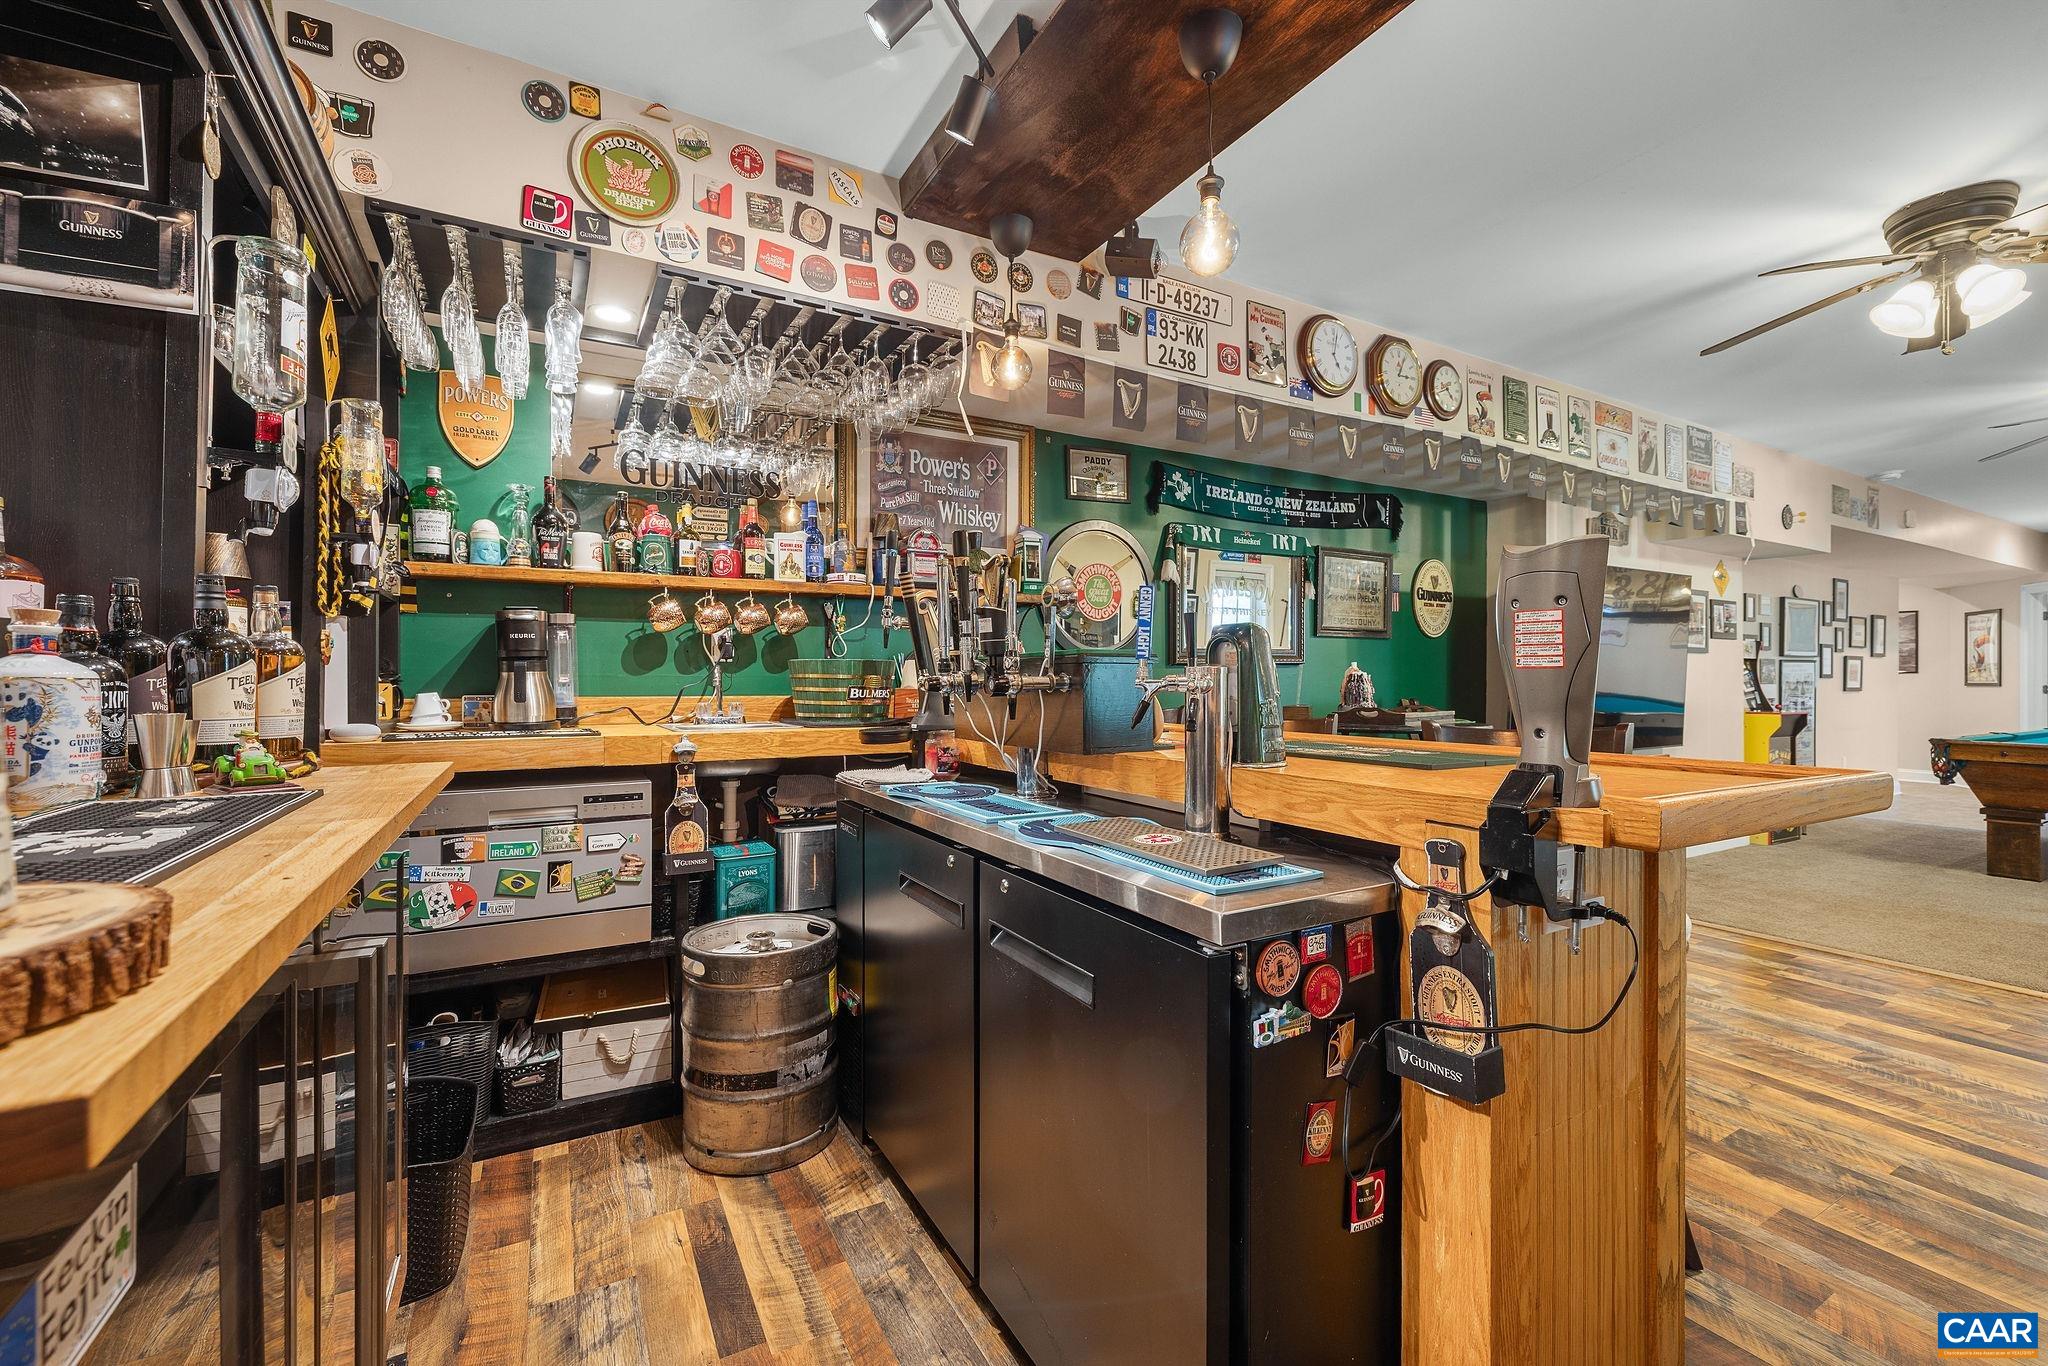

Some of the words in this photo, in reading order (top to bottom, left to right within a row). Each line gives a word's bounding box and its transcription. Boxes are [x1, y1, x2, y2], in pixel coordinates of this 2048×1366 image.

[291, 35, 330, 51] GUINNESS
[592, 136, 664, 171] PHOENIX
[831, 170, 860, 206] RASCALS
[603, 187, 656, 207] DRAUGHT
[615, 197, 644, 211] BEER
[59, 219, 123, 240] GUINNESS
[525, 220, 569, 237] GUINNESS
[579, 230, 609, 241] GUINNESS
[1118, 283, 1128, 293] IRL
[1141, 278, 1220, 319] 11-D-49237
[1249, 313, 1260, 324] My
[1259, 314, 1285, 331] GUINNESS
[1159, 318, 1205, 349] 93-KK
[1158, 343, 1196, 372] 2438
[1048, 376, 1084, 392] GUINNESS
[443, 386, 510, 411] POWERS
[1177, 405, 1208, 420] GUINNESS
[452, 425, 475, 433] GOLD
[476, 426, 499, 437] LABEL
[1289, 427, 1315, 440] GUINNESS
[1383, 443, 1405, 454] GUINNESS
[908, 448, 971, 481] Power's
[986, 458, 997, 477] P
[1084, 455, 1112, 466] PADDY
[1460, 453, 1482, 465] GUINNESS
[620, 449, 782, 499] GUINNESS
[1528, 470, 1547, 482] GUINNESS
[880, 497, 895, 508] Pure
[895, 495, 907, 506] Pot
[906, 491, 920, 503] Still
[1205, 484, 1263, 505] IRELAND
[1274, 495, 1303, 511] NEW
[1305, 499, 1356, 513] ZEALAND
[907, 516, 923, 527] Years
[923, 517, 935, 528] Old
[937, 500, 1002, 533] Whiskey
[1233, 535, 1261, 546] Heineken
[1600, 525, 1618, 540] BAR
[1076, 563, 1121, 592] SMITHWICK'S
[1092, 578, 1106, 588] The
[1088, 587, 1109, 598] great
[1416, 586, 1453, 603] GUINNESS
[1080, 598, 1119, 619] DRAUGHT
[1139, 586, 1152, 622] GENNY
[1137, 626, 1151, 658] LIGHT
[849, 688, 890, 699] BULMERS
[491, 847, 525, 857] IRELAND
[680, 859, 708, 867] GUINNESS
[424, 870, 466, 879] Kilkenny
[738, 868, 758, 877] LYONS
[487, 903, 513, 914] KILKENNY
[1417, 911, 1460, 928] GUINNESS
[1263, 946, 1297, 973] SMITHWICK'S
[1268, 983, 1286, 993] IRISH
[1423, 972, 1443, 1001] GUINNESS
[1442, 970, 1467, 990] EXTRA
[1466, 987, 1482, 1017] STOUT
[1310, 1003, 1325, 1015] IRISH
[1409, 1054, 1464, 1083] GUINNESS
[1351, 1213, 1384, 1235] GUINNESS
[41, 1191, 129, 1315] Feckin
[41, 1242, 115, 1363] Eejit
